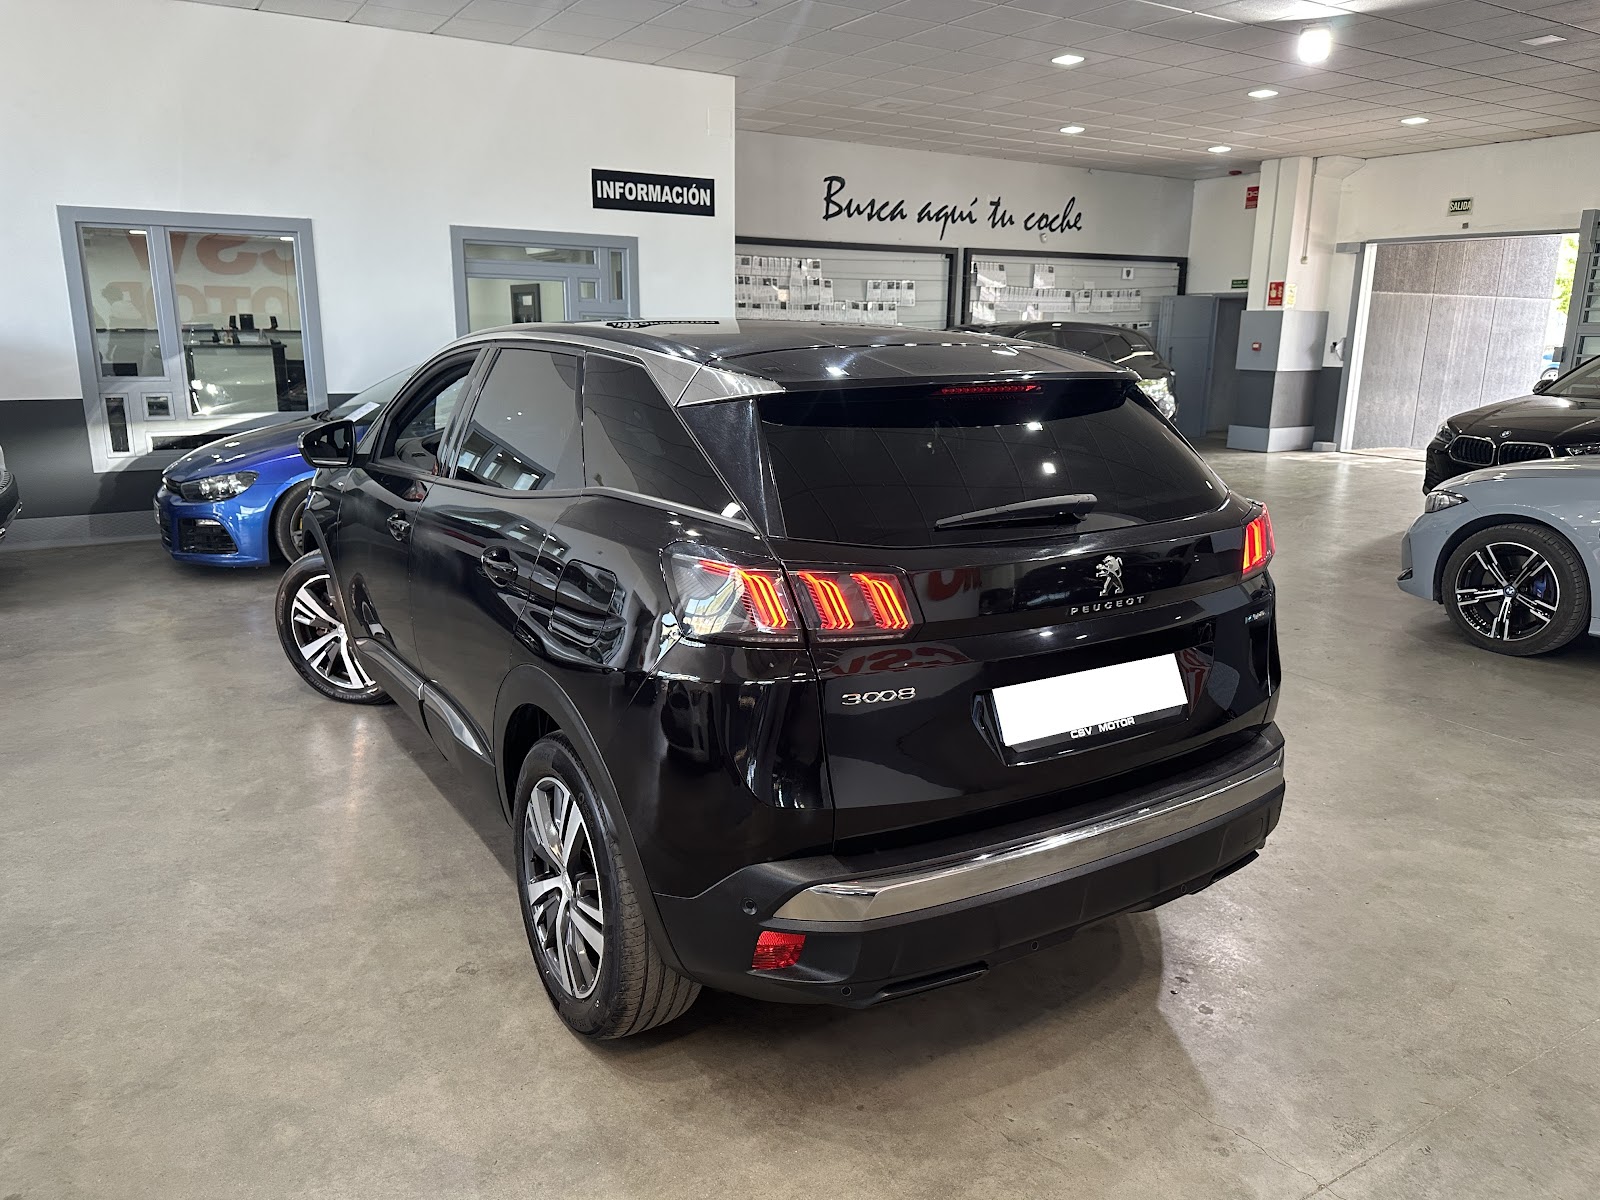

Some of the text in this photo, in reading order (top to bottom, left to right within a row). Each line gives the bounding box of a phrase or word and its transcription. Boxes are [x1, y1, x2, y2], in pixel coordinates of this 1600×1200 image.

[596, 180, 711, 206] INFORMACIÓN
[822, 175, 1083, 241] Busca aquí tu coche
[1449, 200, 1471, 211] SALIDA
[1070, 596, 1145, 615] PEUGEOT
[841, 686, 917, 706] 3008
[1070, 716, 1136, 739] CSV MOTOR
